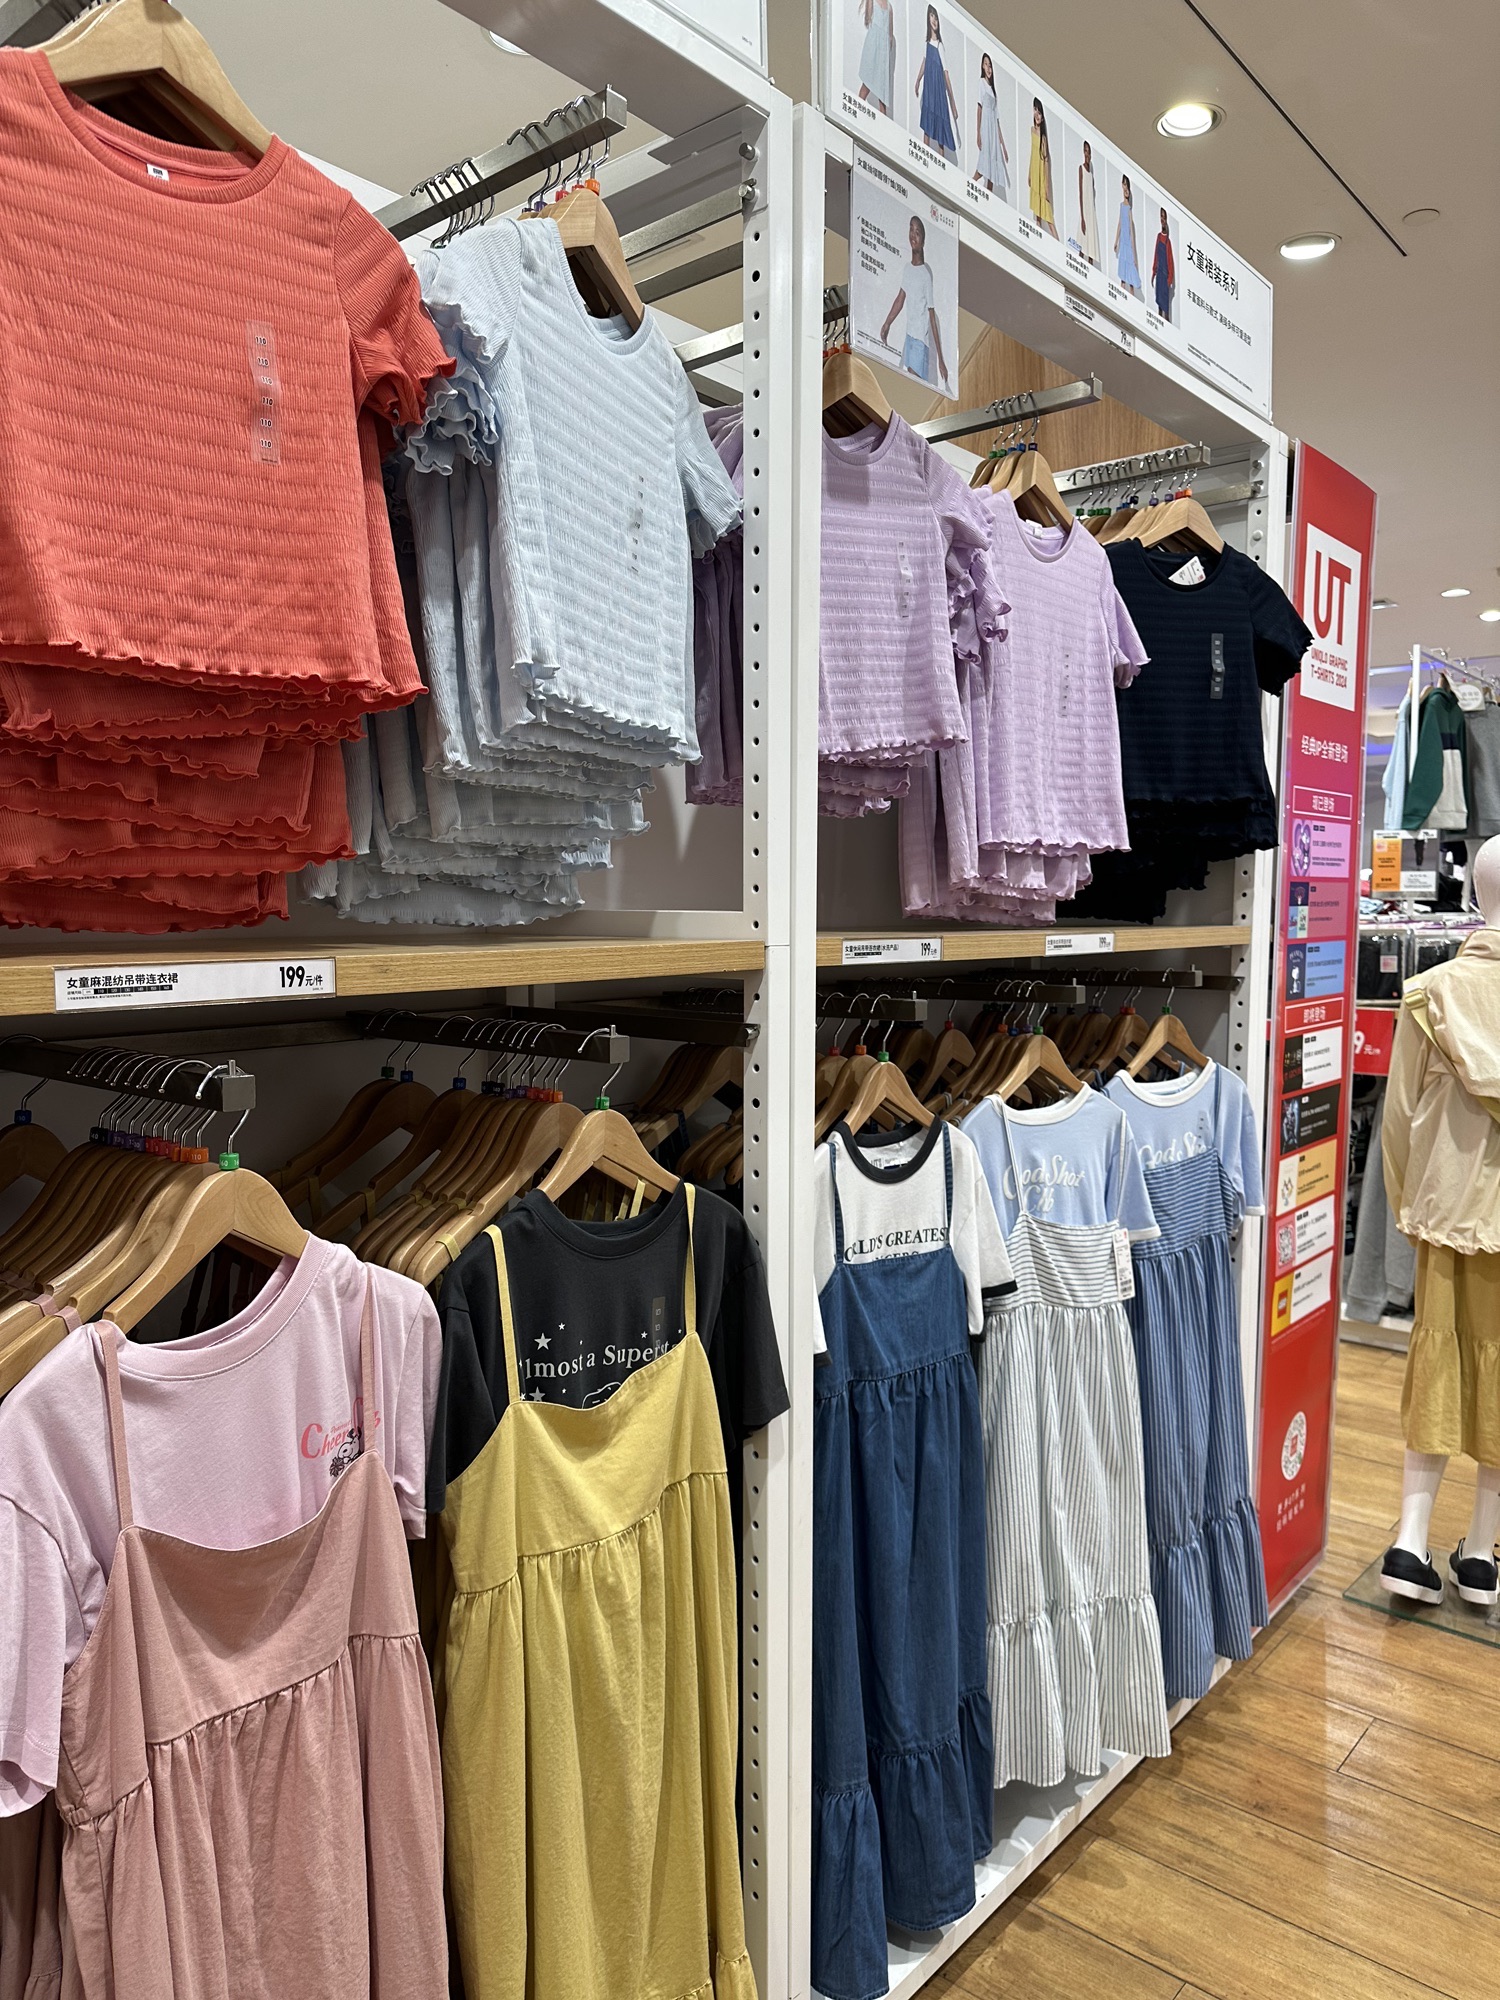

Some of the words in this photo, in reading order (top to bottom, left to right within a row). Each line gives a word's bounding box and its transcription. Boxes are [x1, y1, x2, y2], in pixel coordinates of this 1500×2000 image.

[1186, 241, 1239, 302] 女童裙装系列
[256, 336, 267, 345] 110
[258, 357, 269, 366] 110
[262, 376, 272, 385] 110
[262, 397, 273, 406] 110
[261, 418, 272, 427] 110
[261, 439, 272, 448] 110
[1315, 549, 1351, 646] UT
[1311, 647, 1328, 665] UNIQLO
[1329, 652, 1348, 671] GRAPHIC
[1311, 664, 1334, 684] T-SHIRTS
[1336, 671, 1347, 688] 2024
[67, 972, 179, 988] 女童麻混纺吊带连衣裙
[525, 1353, 583, 1379] lmost
[586, 1352, 595, 1367] a
